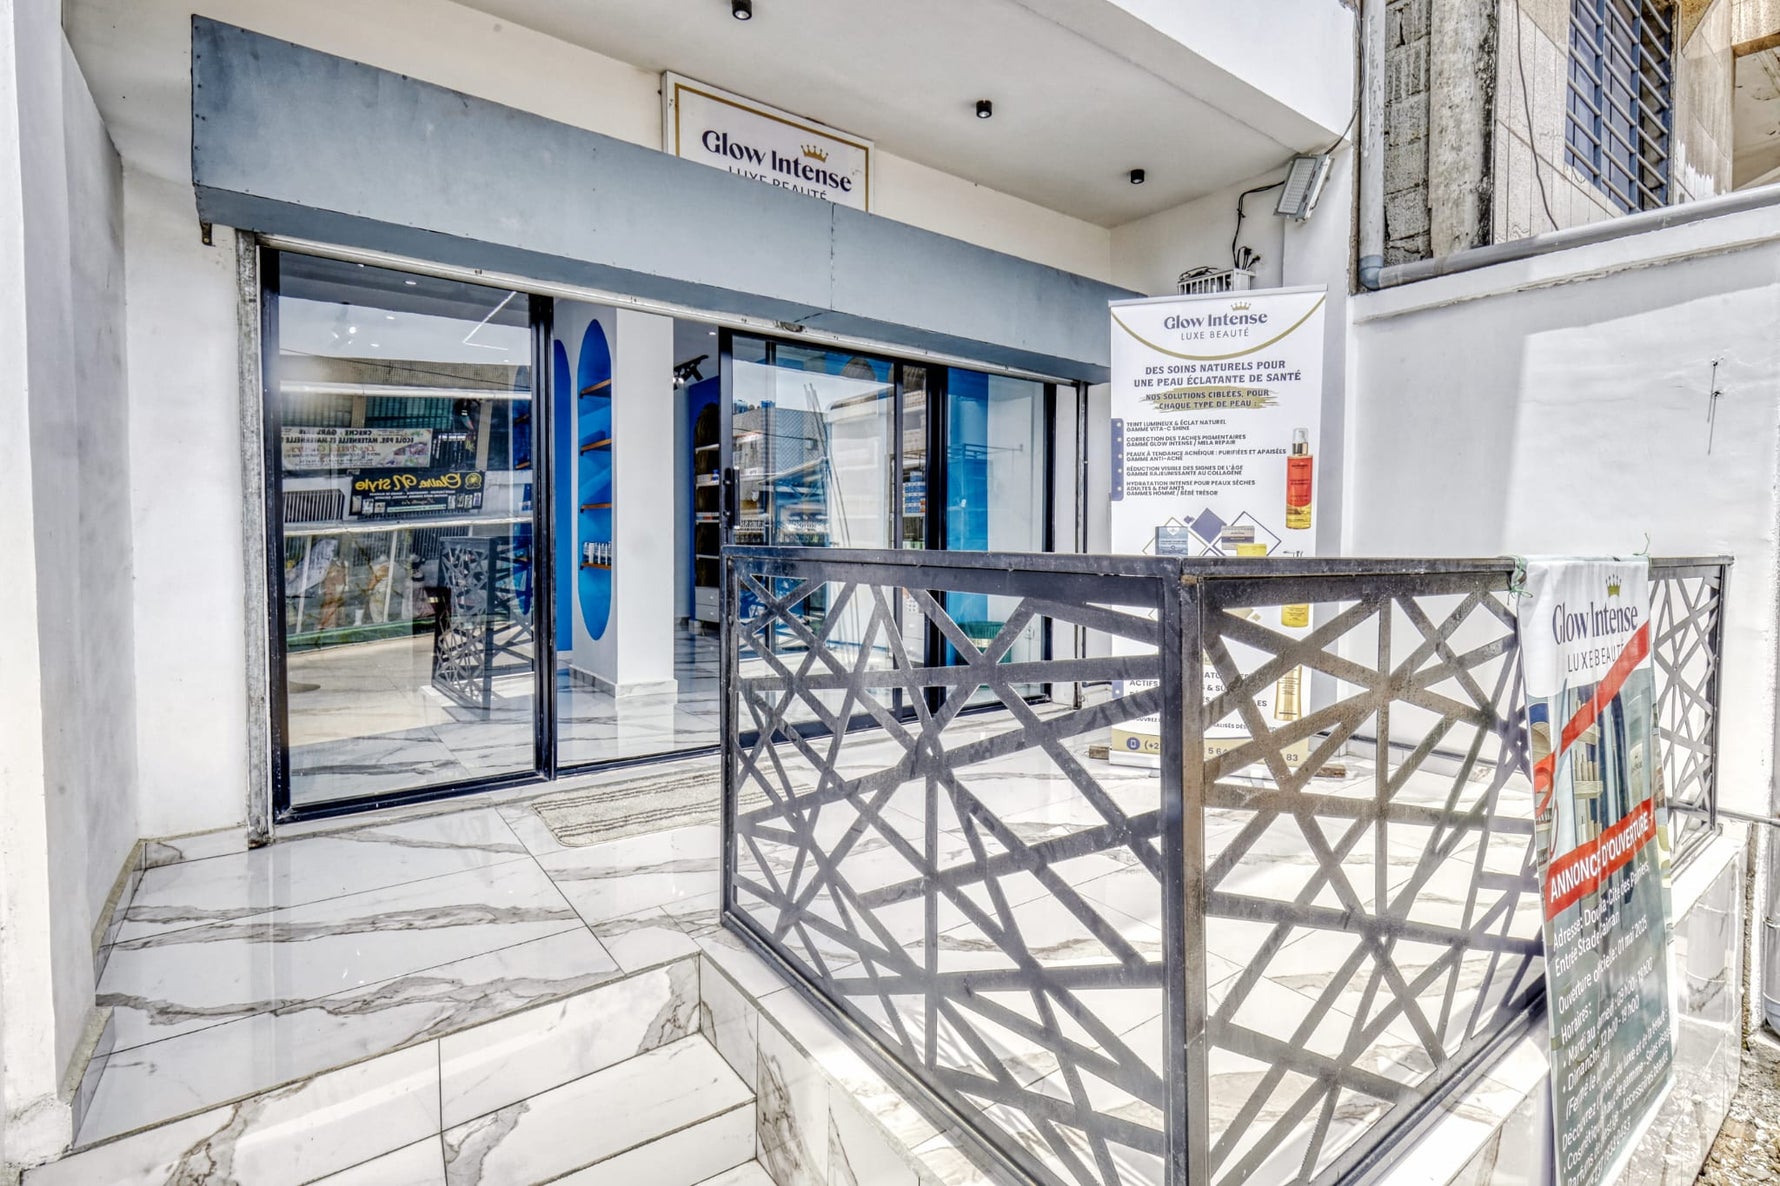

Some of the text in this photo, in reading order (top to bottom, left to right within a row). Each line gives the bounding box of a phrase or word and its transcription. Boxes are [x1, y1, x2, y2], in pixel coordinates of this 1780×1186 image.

[702, 130, 852, 193] Glow Intense
[1164, 310, 1268, 331] Glow Intense
[1181, 327, 1249, 341] LUXE BEAUTÉ
[1145, 360, 1286, 376] DES SOINS NATURELS POUR
[1134, 369, 1302, 388] UNE PEAU ÉCLATANTE DE SANTÉ
[1146, 393, 1161, 401] NOS
[1163, 391, 1206, 400] SOLUTIONS
[1246, 388, 1270, 398] POUR
[1159, 402, 1192, 410] CHAQUE
[1194, 401, 1214, 409] TYPE
[1230, 400, 1252, 408] PEAU
[1552, 601, 1638, 645] Glow Intense
[1602, 811, 1648, 868] D'OUVERTURE
[1559, 974, 1592, 1014] Ouverture
